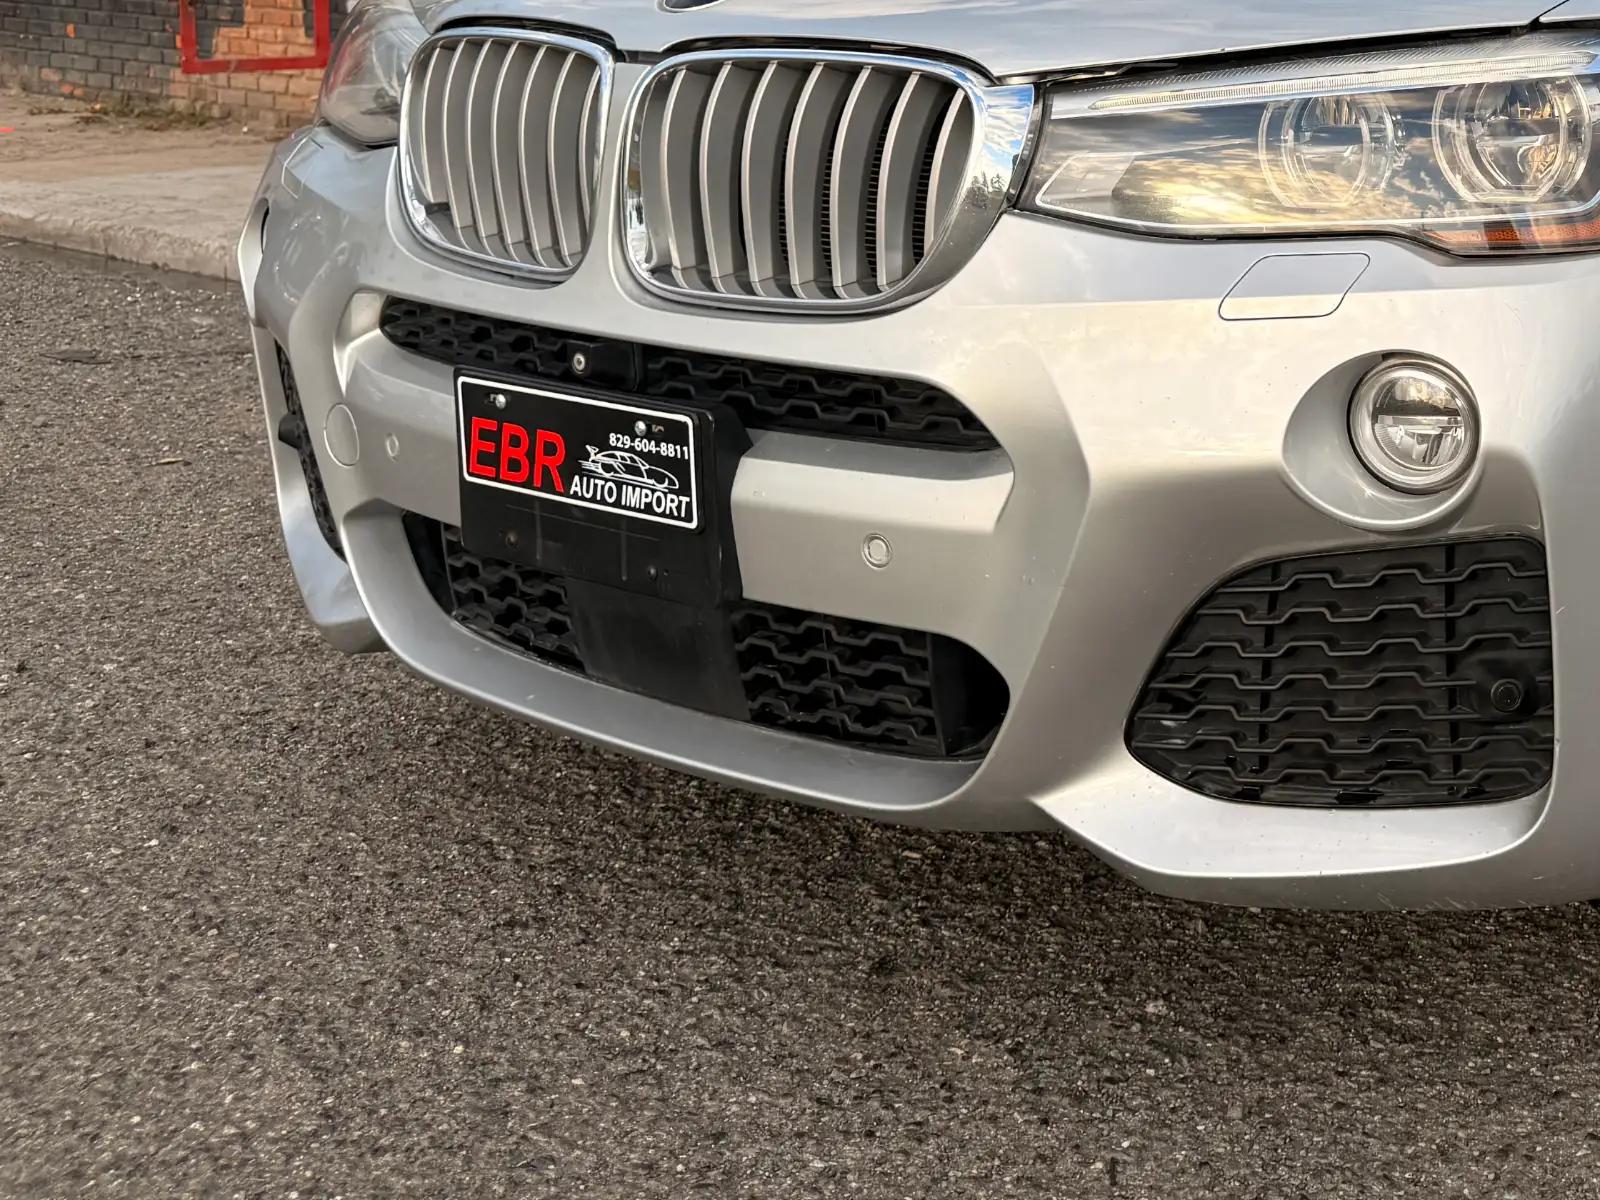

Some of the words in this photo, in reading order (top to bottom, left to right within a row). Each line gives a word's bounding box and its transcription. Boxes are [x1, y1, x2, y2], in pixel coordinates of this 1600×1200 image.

[469, 416, 566, 493] EBR
[609, 432, 689, 460] 829-604-8811
[569, 474, 617, 503] AUTO
[621, 485, 690, 518] IMPORT
